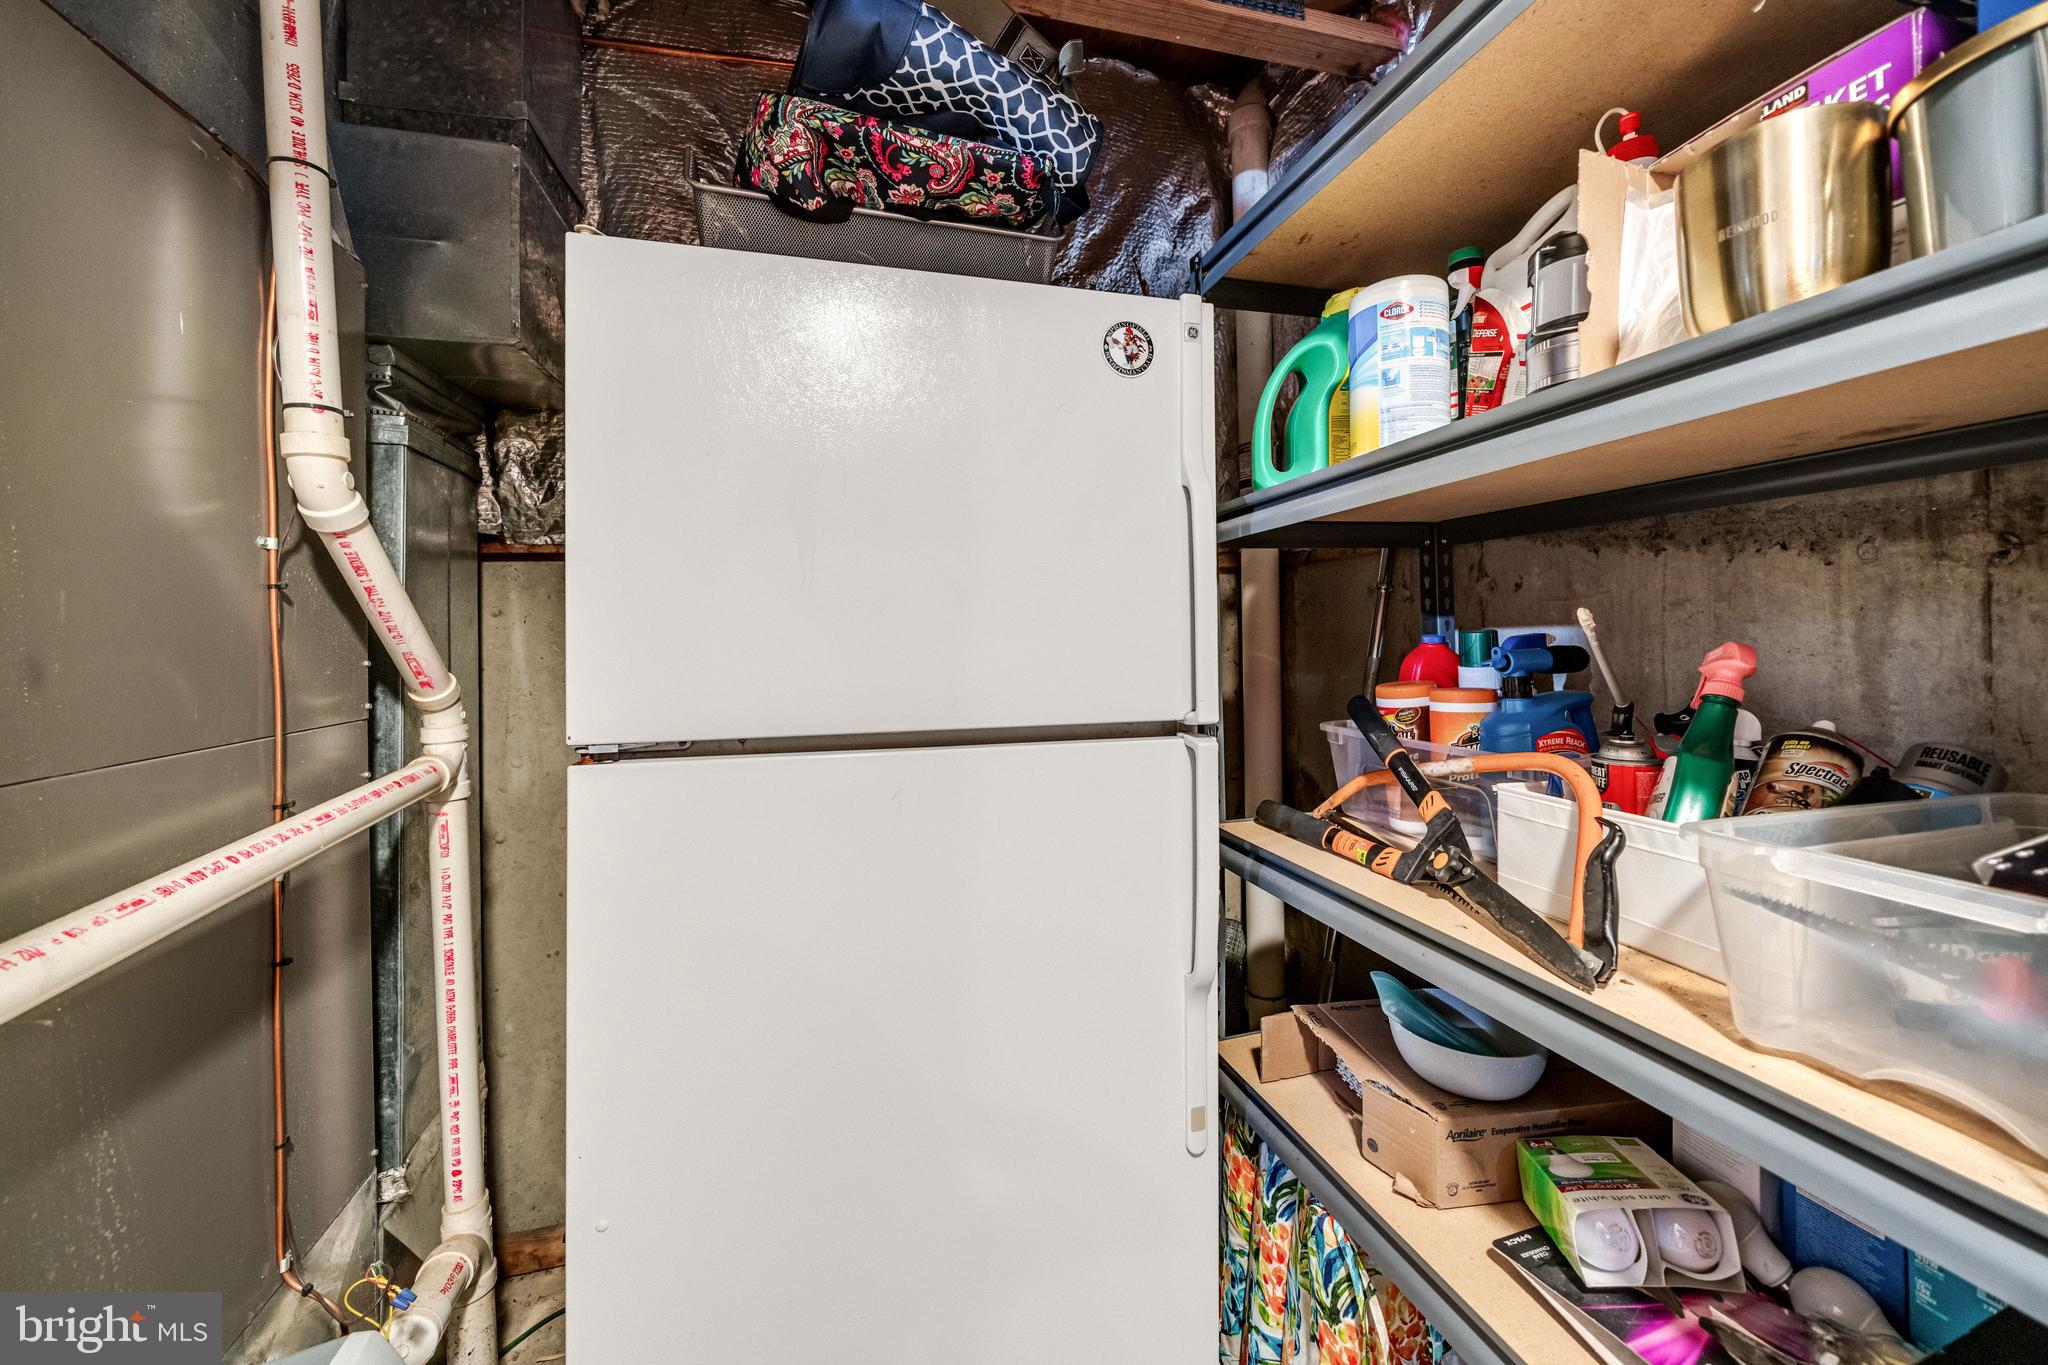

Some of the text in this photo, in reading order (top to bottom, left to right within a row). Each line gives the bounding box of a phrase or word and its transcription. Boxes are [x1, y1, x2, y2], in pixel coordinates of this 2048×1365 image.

[1808, 62, 1893, 108] KET
[1762, 85, 1807, 119] LAND
[291, 130, 308, 169] SHEDULE
[1472, 328, 1498, 338] DEFENSE
[1538, 736, 1585, 748] XTREME REACH
[1920, 746, 1992, 776] REUSABLE
[1398, 766, 1418, 792] FISKARS
[444, 948, 456, 976] SCHEDULE
[445, 988, 456, 1005] ASTM
[446, 1025, 458, 1056] CHARLOTTE
[447, 1057, 458, 1069] PIPE
[1446, 1127, 1485, 1142] Aprilaire
[1491, 1126, 1531, 1136] Evaporative
[1584, 1183, 1623, 1191] Longer
[1572, 1195, 1608, 1203] white
